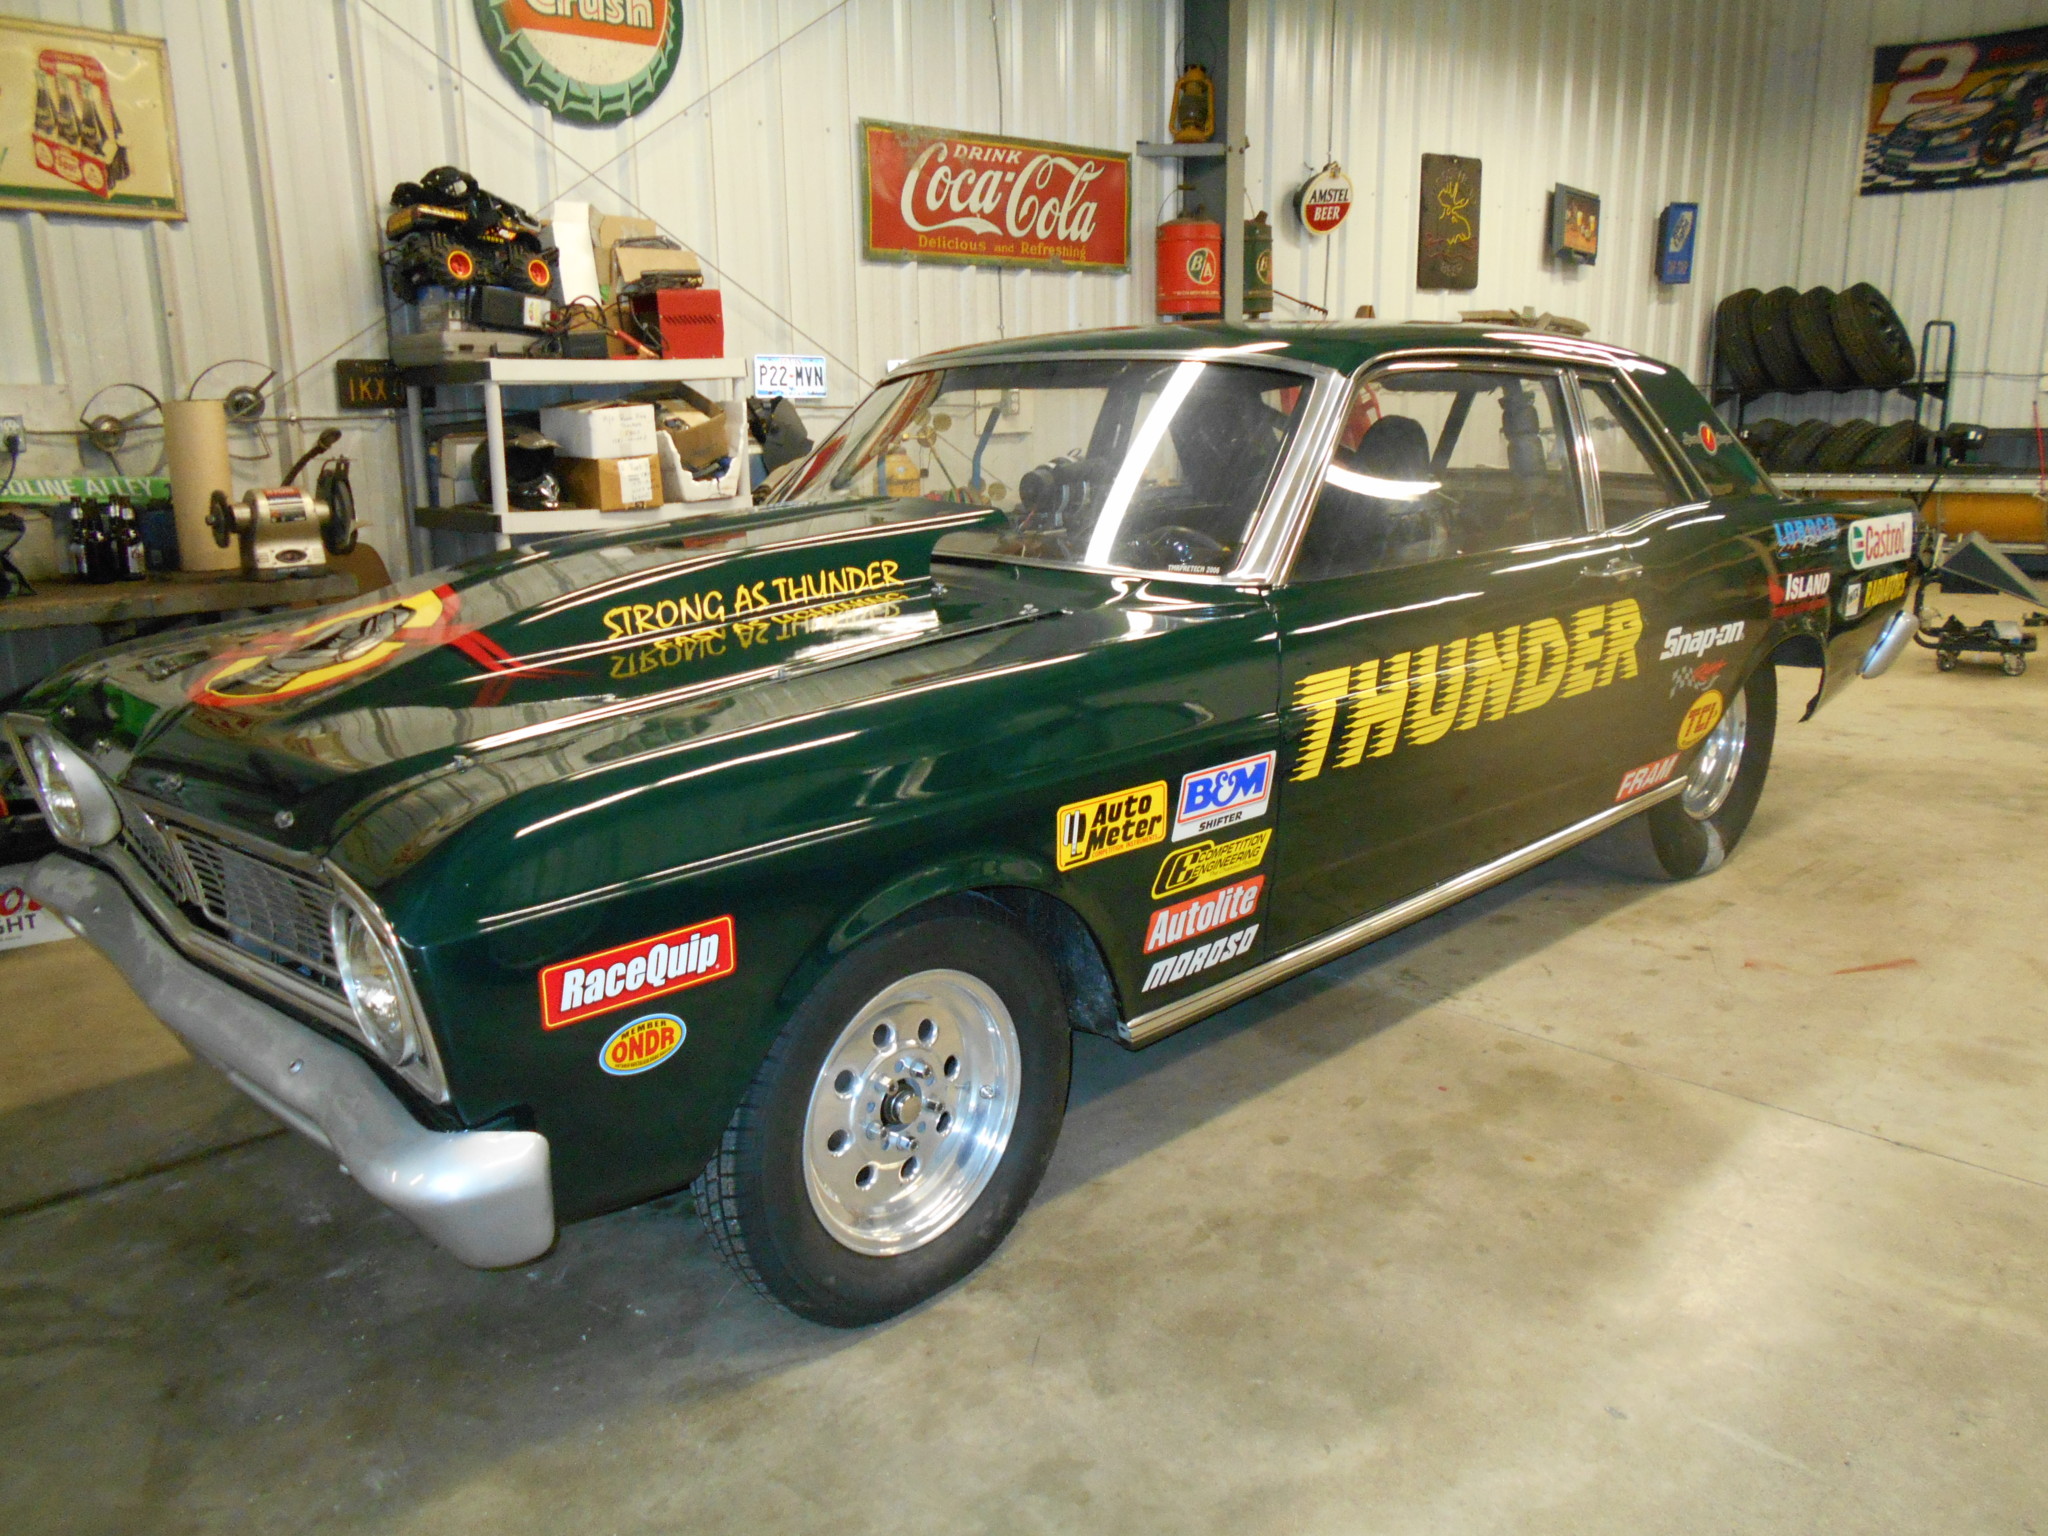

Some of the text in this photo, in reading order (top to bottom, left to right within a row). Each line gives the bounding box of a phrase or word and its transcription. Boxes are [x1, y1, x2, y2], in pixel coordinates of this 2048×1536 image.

[953, 144, 1022, 164] DRINK
[1309, 188, 1349, 203] AMSTEL
[1314, 206, 1340, 222] BEER
[918, 234, 1086, 261] Delicious and Refreshing
[86, 478, 152, 497] ALLEY
[1866, 521, 1906, 561] Castrol
[603, 560, 905, 640] STRONG AS THUNDER
[1660, 621, 1744, 660] Snap-on
[1289, 598, 1643, 782] THUNDER
[1183, 761, 1268, 815] B&M
[1616, 754, 1680, 799] FRAM
[1091, 794, 1152, 829] Auto
[1198, 811, 1243, 832] SHIFTER
[1084, 814, 1163, 859] Meter
[1198, 832, 1266, 864] COMPETITION
[1191, 846, 1261, 877] ENGINEERING
[1147, 883, 1258, 951] Autolite
[560, 933, 719, 1012] RaceQuip
[611, 1026, 675, 1064] ONDR
[621, 1020, 667, 1041] MEMBER
